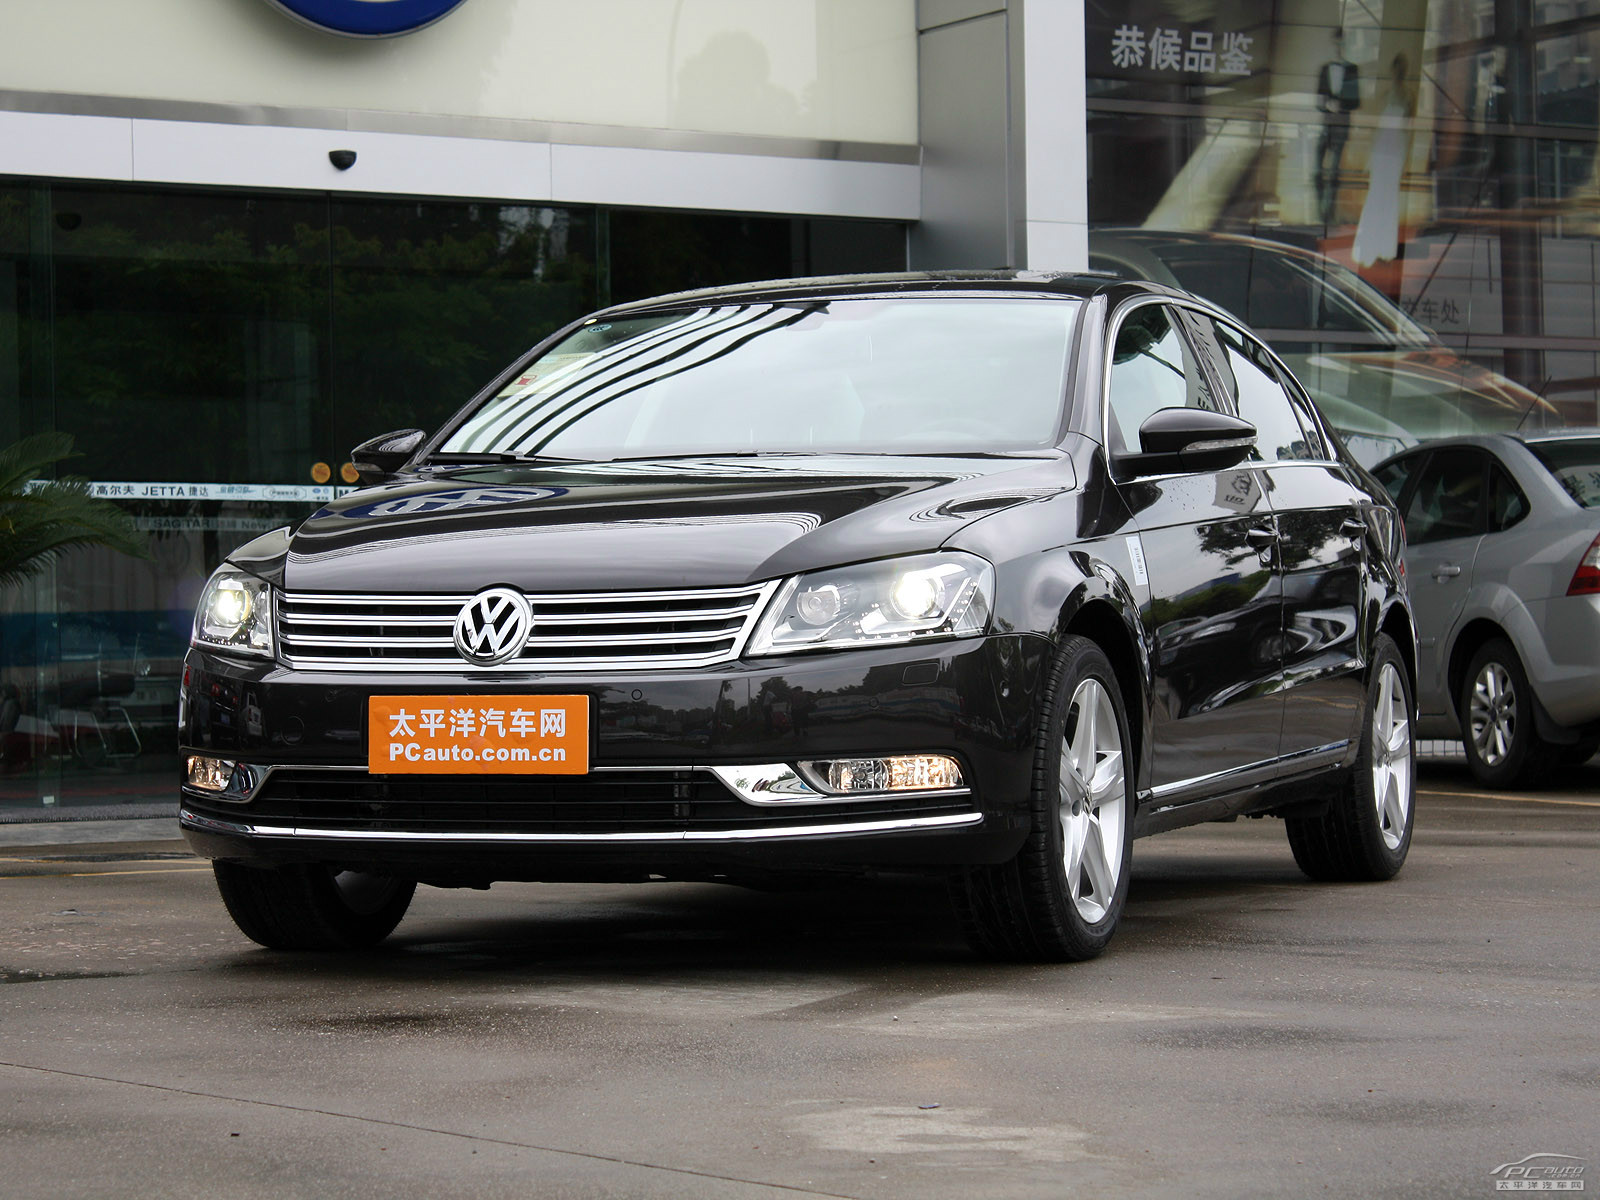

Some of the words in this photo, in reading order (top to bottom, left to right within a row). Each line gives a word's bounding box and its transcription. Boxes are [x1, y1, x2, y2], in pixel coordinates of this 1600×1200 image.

[1111, 24, 1253, 76] 恭候品鉴
[96, 485, 135, 496] 高尔夫
[141, 486, 185, 497] JETTA
[189, 486, 209, 497] 捷达
[389, 708, 566, 738] 太平洋汽车网
[389, 743, 566, 762] PCauto.com.cn
